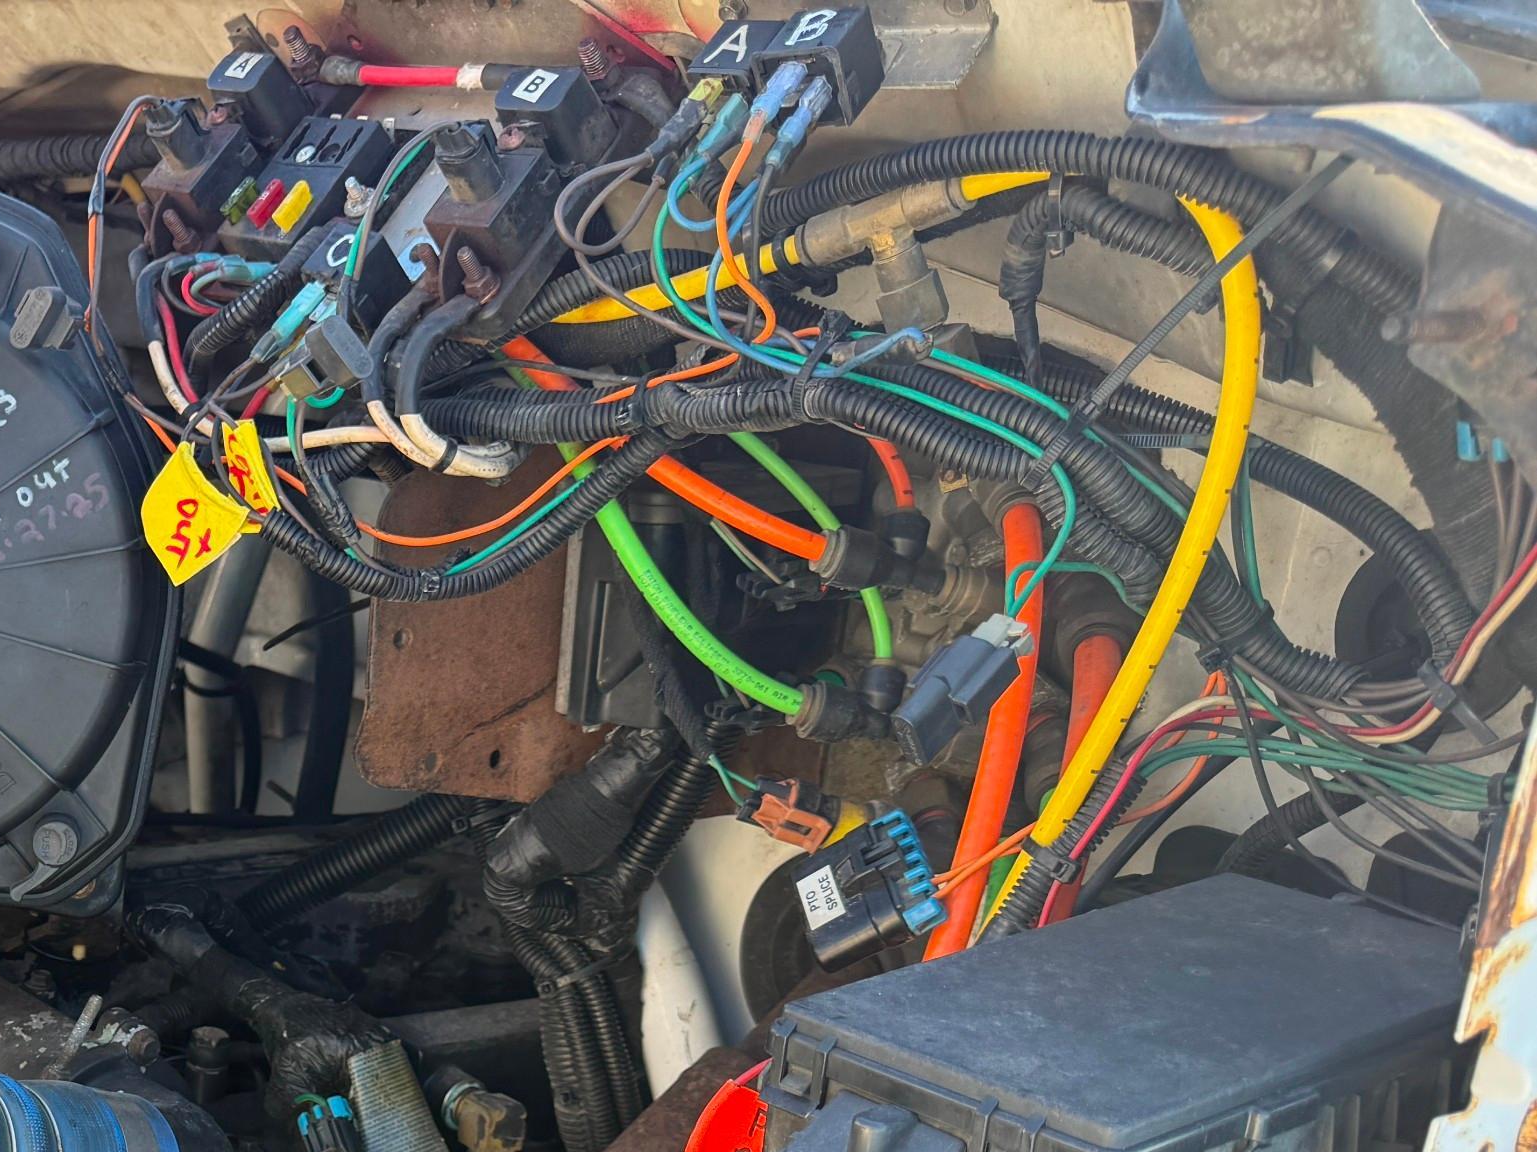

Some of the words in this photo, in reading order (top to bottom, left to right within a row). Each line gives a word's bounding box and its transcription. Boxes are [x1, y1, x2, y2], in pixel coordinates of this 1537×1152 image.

[703, 24, 749, 63] A
[785, 9, 837, 46] B
[235, 58, 251, 74] A
[530, 76, 547, 94] B
[326, 234, 355, 268] C
[805, 890, 821, 912] PTO
[818, 873, 838, 911] SPLICE
